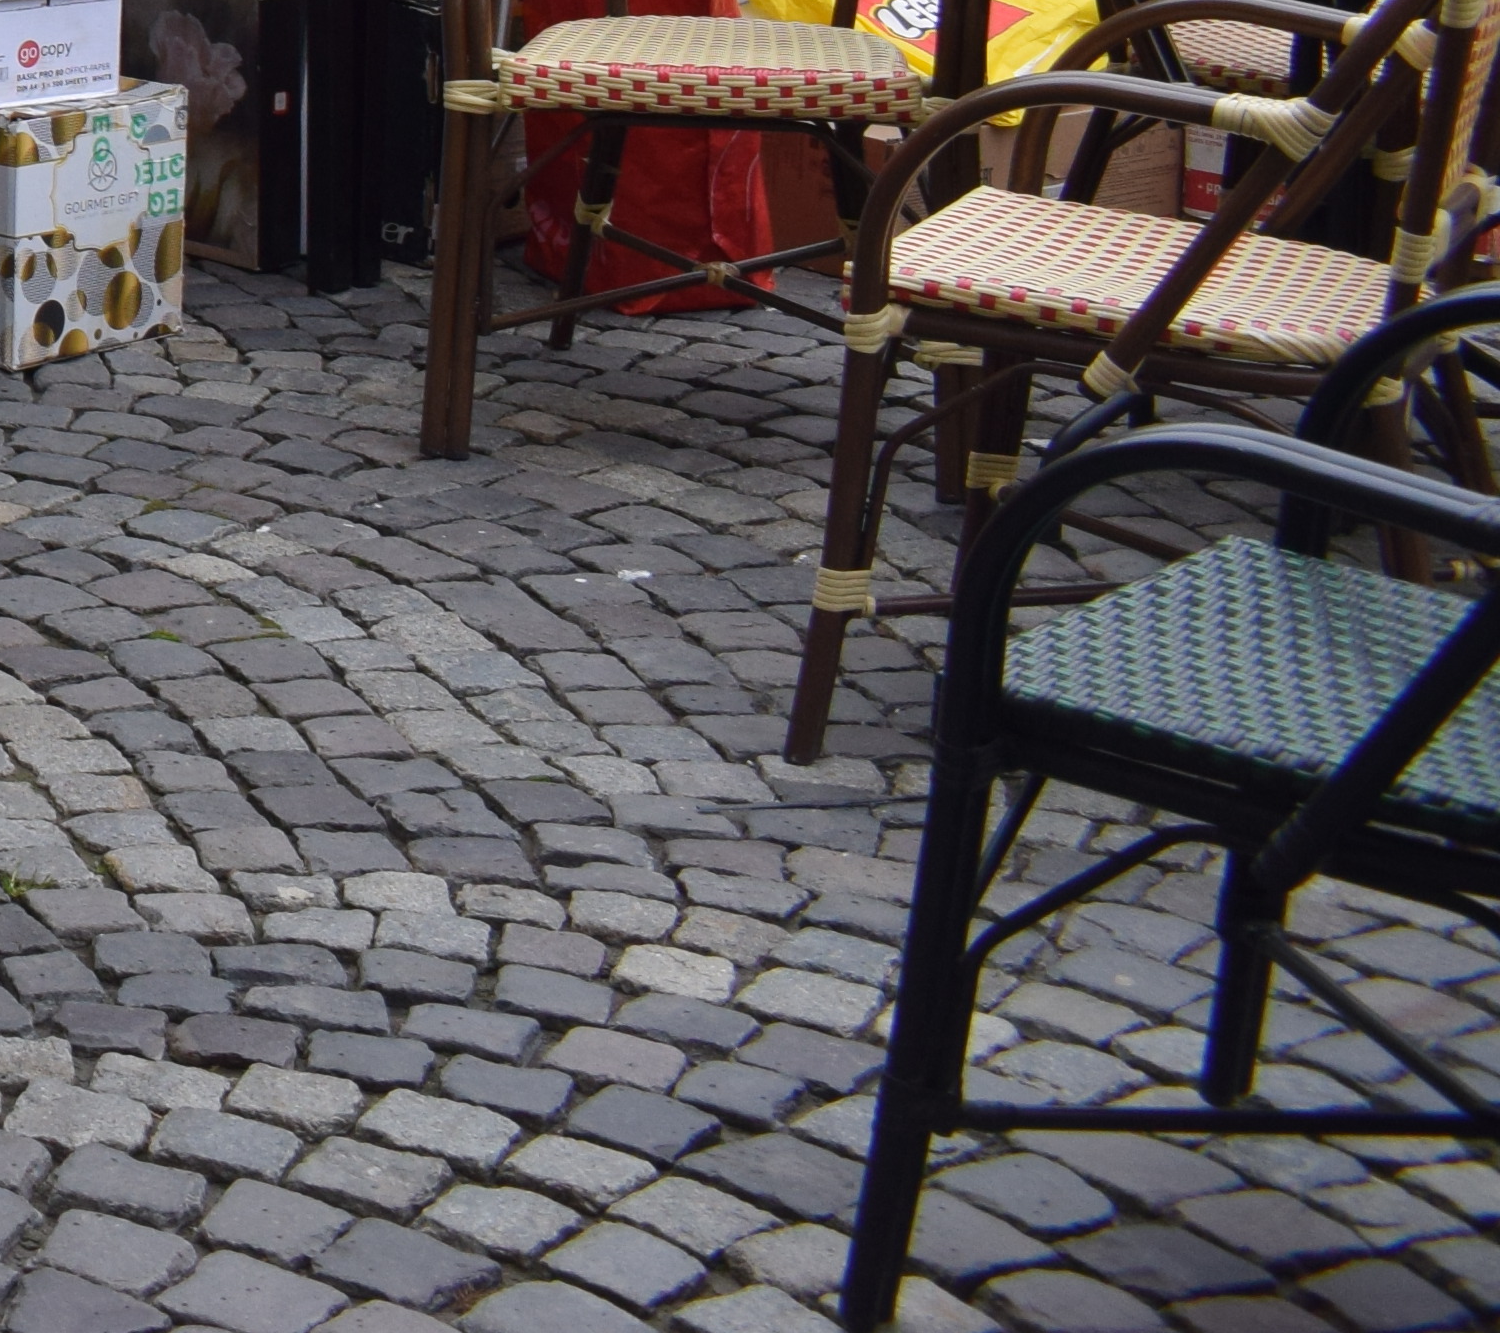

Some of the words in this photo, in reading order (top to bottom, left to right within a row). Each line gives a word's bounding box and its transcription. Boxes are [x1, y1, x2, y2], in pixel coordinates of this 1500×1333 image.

[19, 46, 38, 63] go
[40, 40, 73, 58] copy
[16, 71, 38, 82] BASIC
[38, 69, 54, 79] PRO
[64, 76, 88, 87] SHEETS
[64, 195, 115, 216] GOURMET
[117, 190, 140, 206] GIFT
